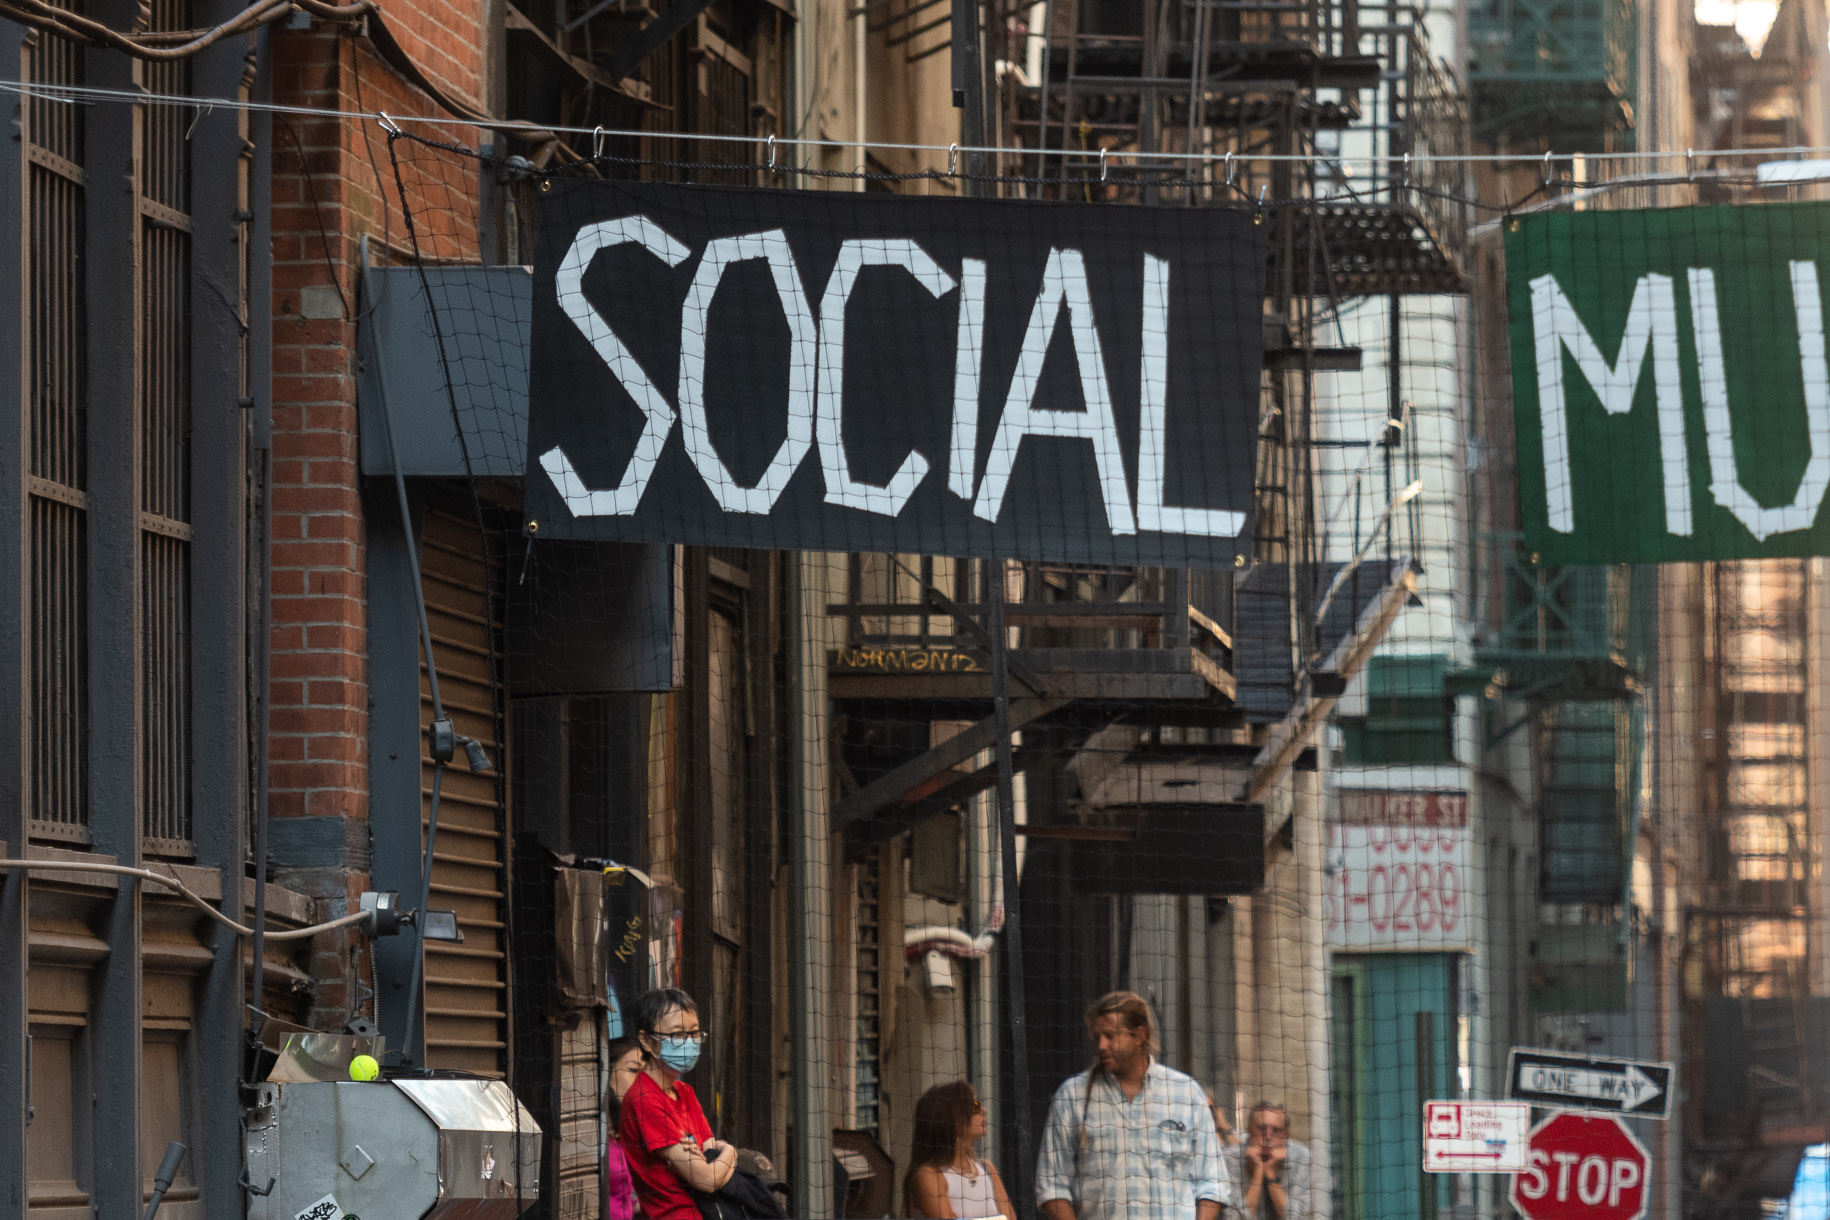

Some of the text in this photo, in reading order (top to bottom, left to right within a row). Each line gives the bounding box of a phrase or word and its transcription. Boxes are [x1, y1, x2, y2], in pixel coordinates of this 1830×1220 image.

[538, 214, 1246, 537] SOCIAL
[1532, 1068, 1646, 1098] ONE WAY
[1520, 1149, 1640, 1207] STOP
